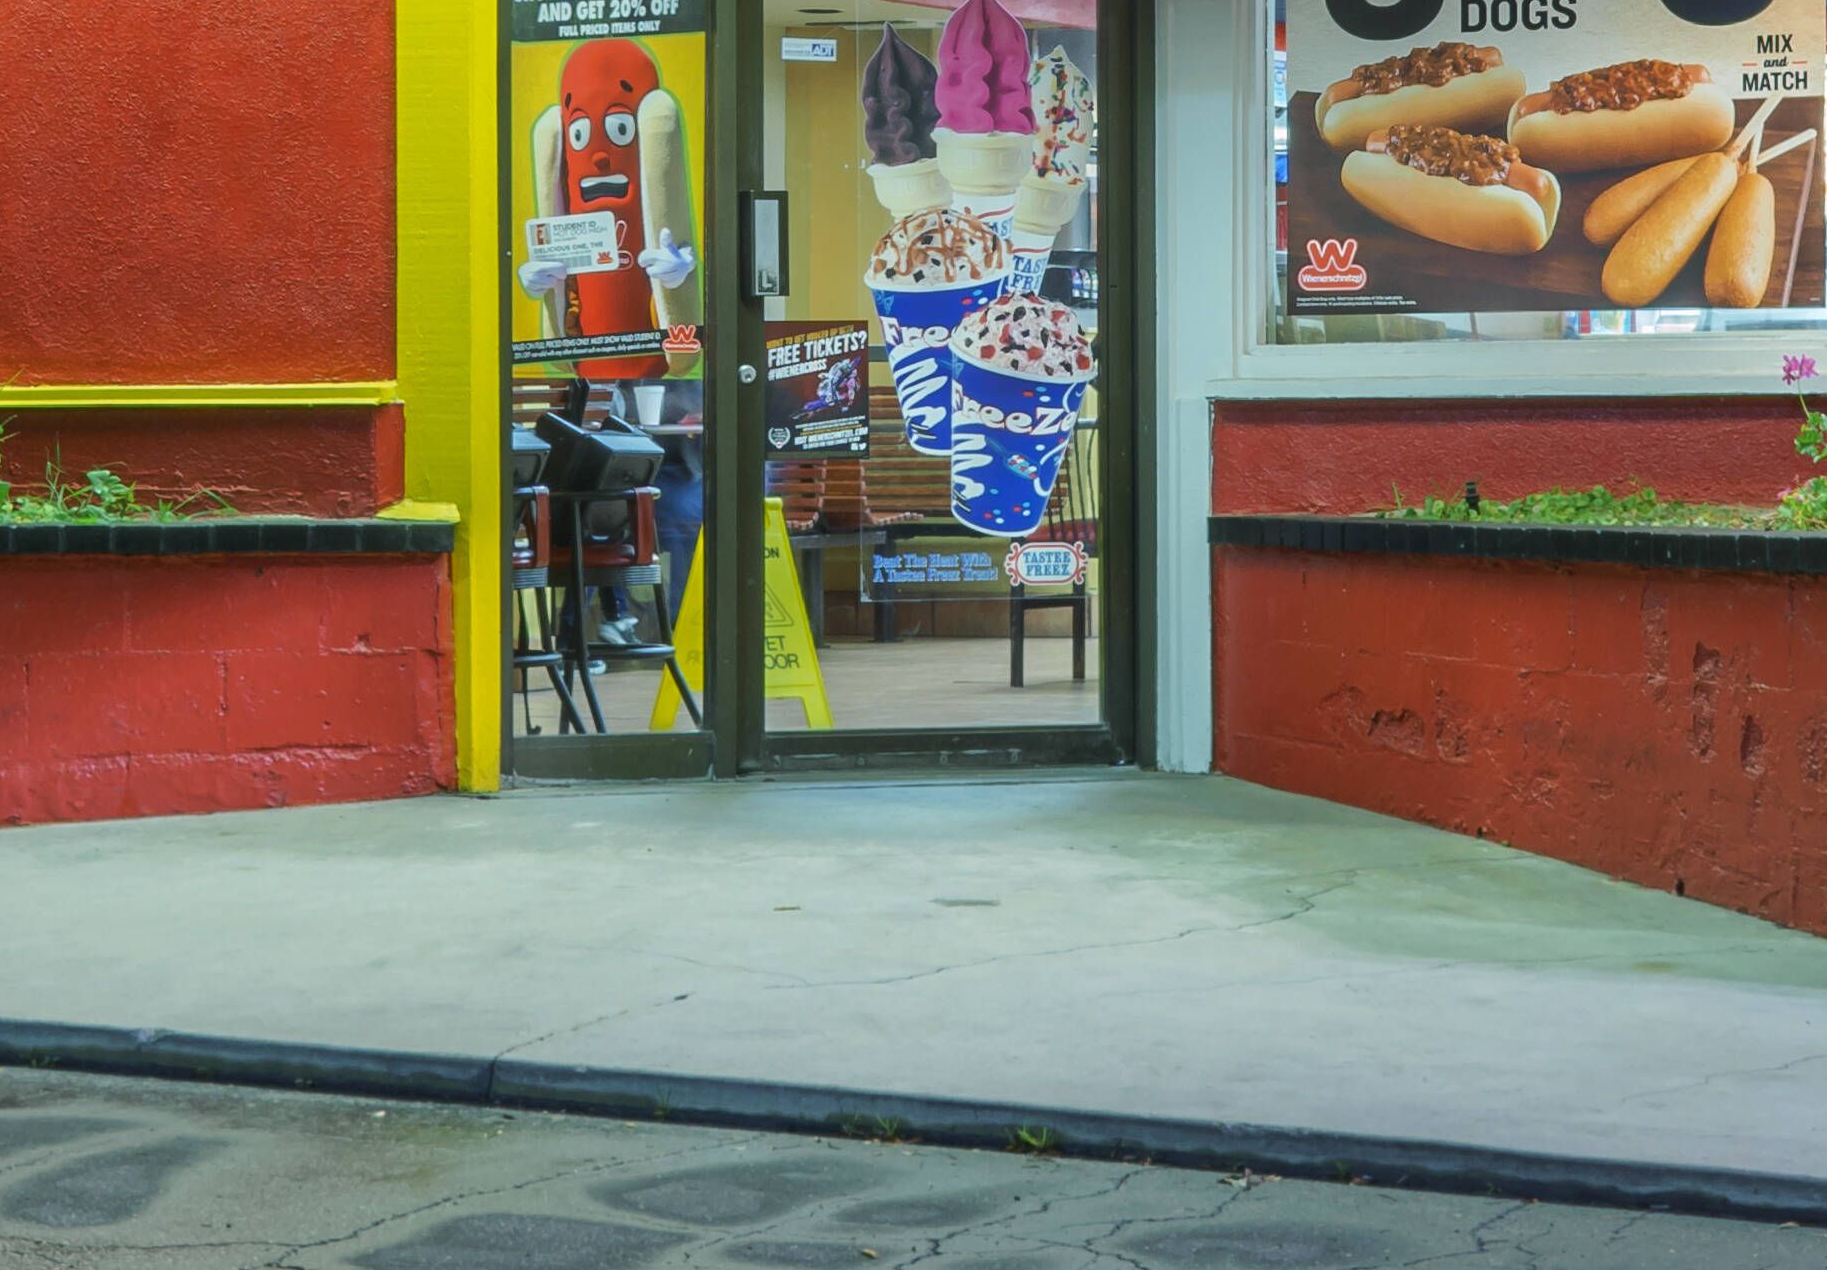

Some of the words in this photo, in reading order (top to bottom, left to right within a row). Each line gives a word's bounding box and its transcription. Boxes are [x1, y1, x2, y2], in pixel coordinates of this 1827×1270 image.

[538, 2, 572, 22] AND
[576, 0, 606, 20] GET
[558, 25, 579, 38] FULL
[579, 23, 610, 36] PRICED
[611, 21, 637, 34] ITEMS
[637, 20, 662, 32] ONLY
[811, 43, 835, 57] ADT
[1756, 34, 1794, 54] MIX
[1762, 56, 1788, 69] and
[1741, 71, 1809, 93] MATCH
[552, 222, 587, 231] STUDENT
[1013, 255, 1048, 273] TAS
[879, 315, 957, 347] Fre
[767, 343, 800, 368] FREE
[803, 329, 867, 360] TICKETS?
[1023, 551, 1071, 564] TASTEE
[1026, 564, 1071, 577] FREEZ
[764, 635, 786, 651] ET
[764, 653, 800, 670] OOR
